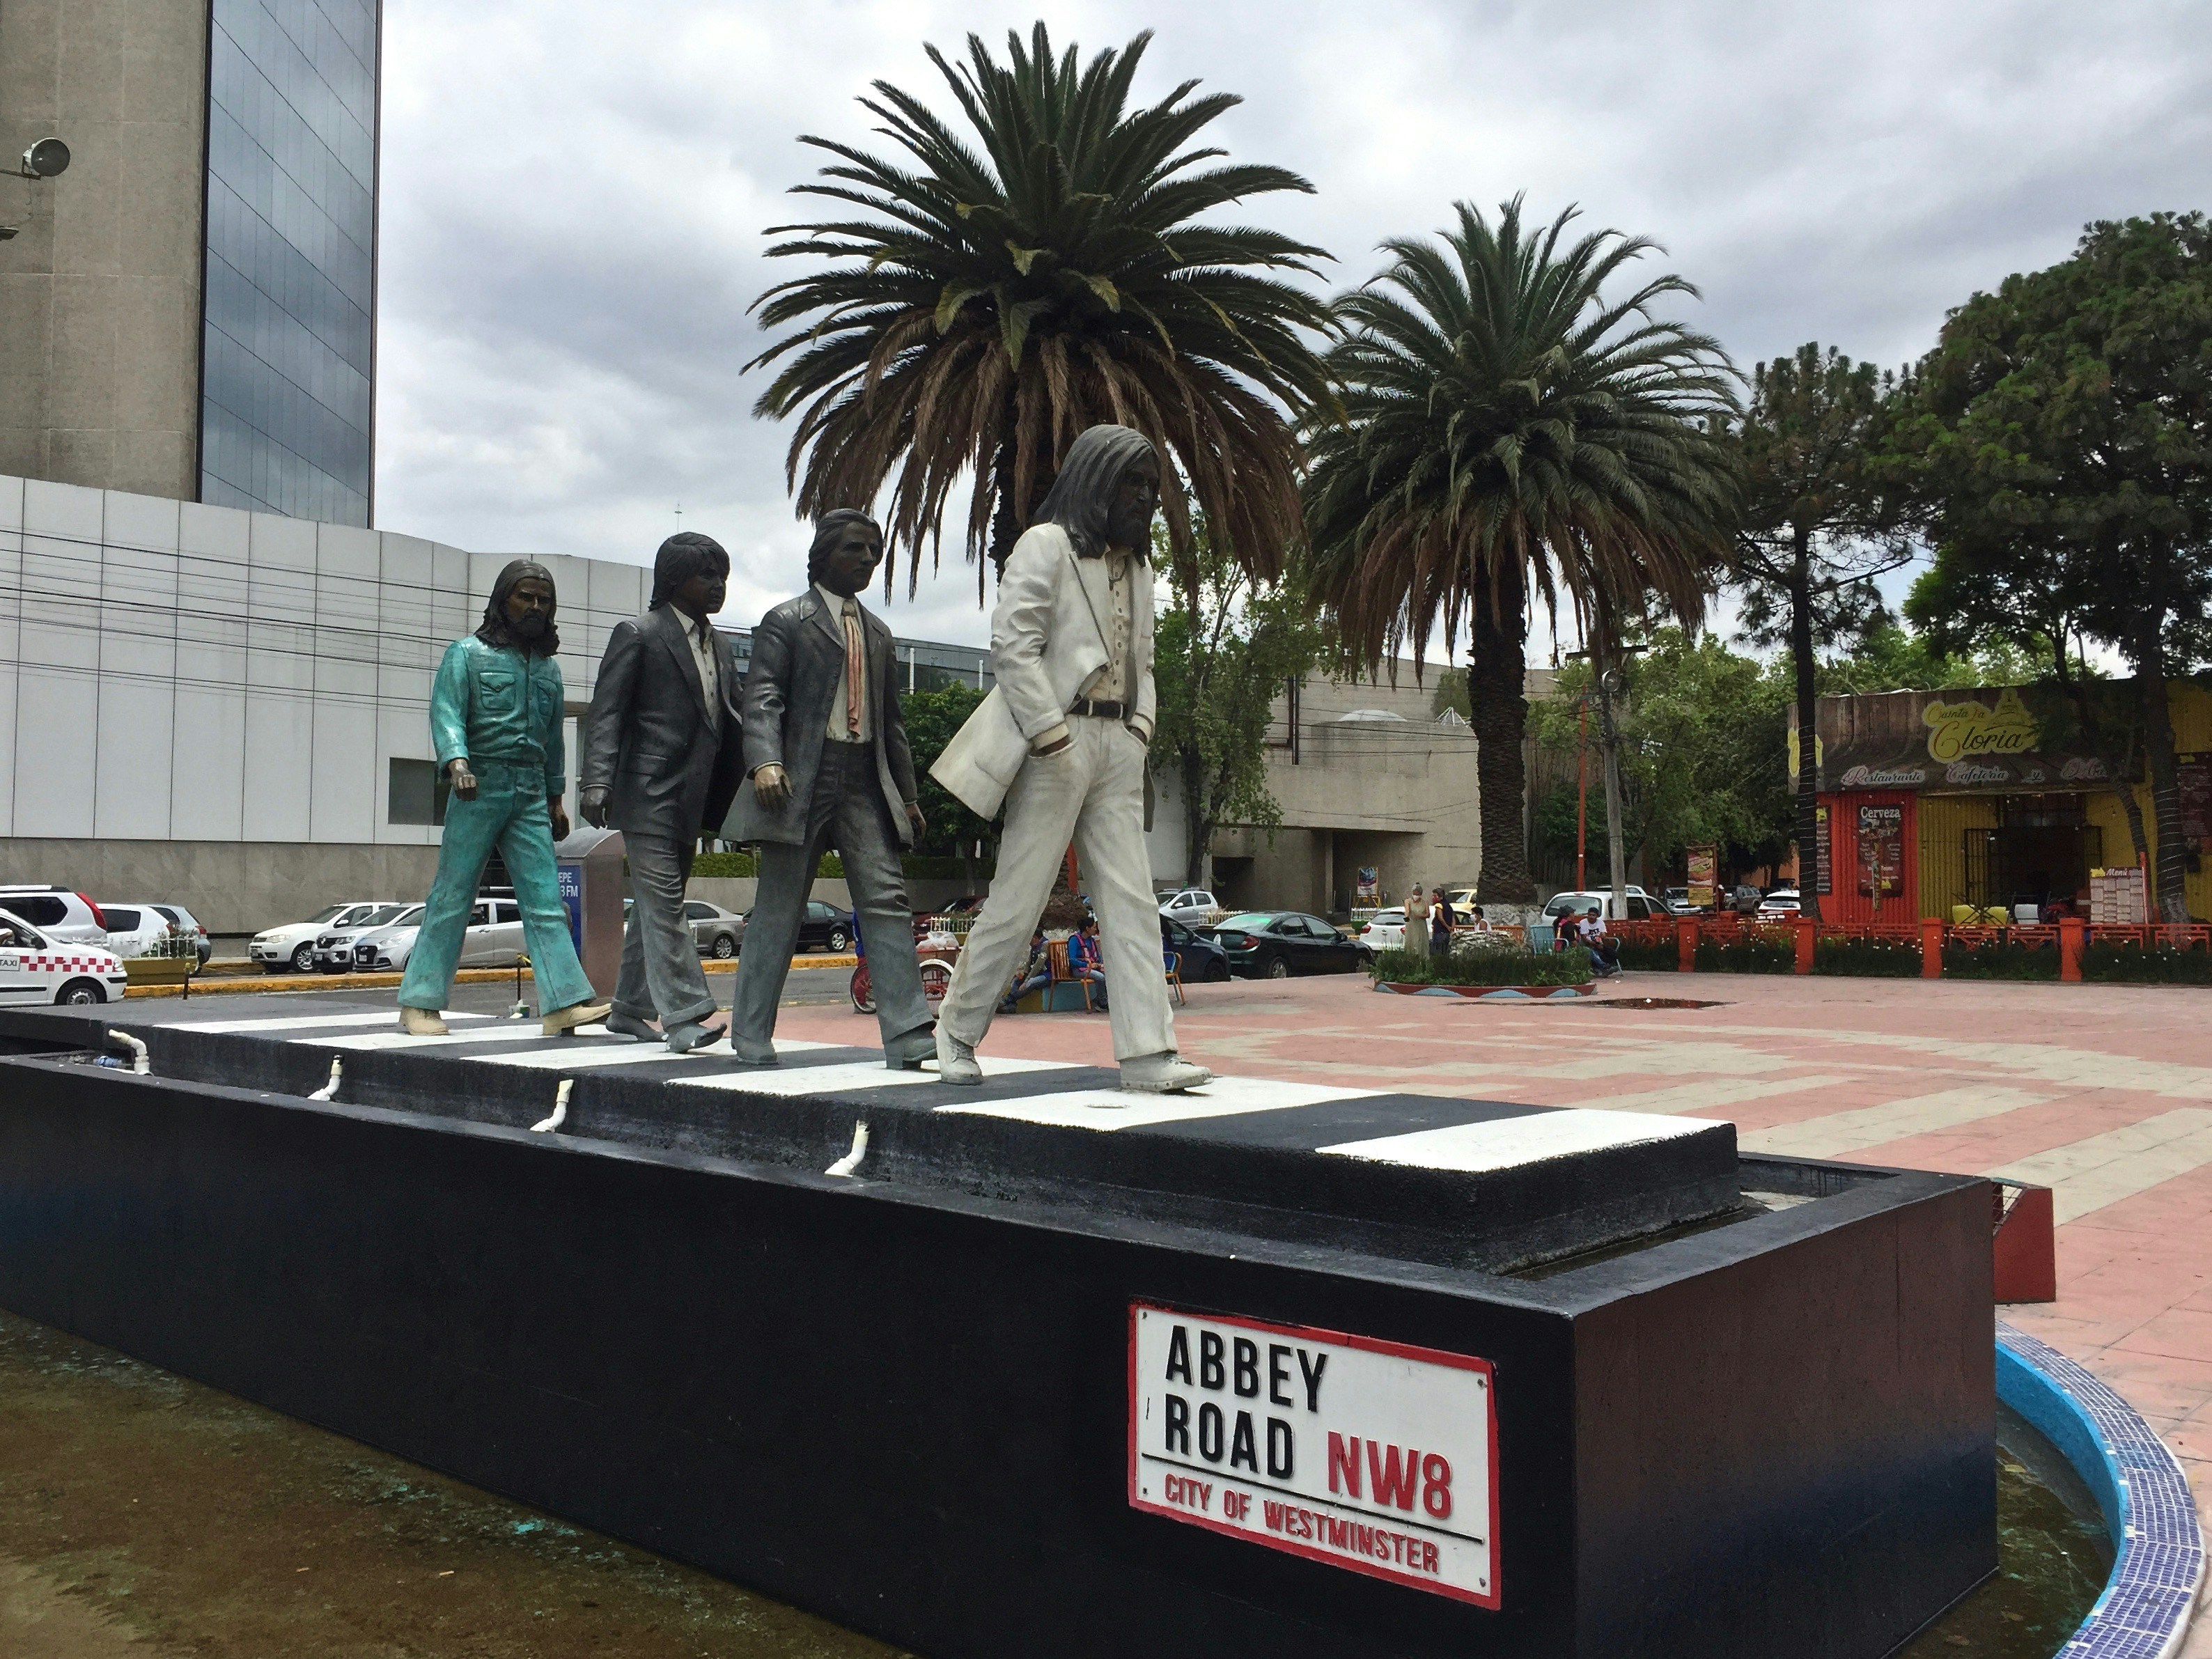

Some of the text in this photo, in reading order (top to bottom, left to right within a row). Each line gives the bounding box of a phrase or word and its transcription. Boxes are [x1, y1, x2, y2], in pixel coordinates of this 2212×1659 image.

[1933, 720, 2023, 758] Gloria
[1841, 767, 1922, 785] Restaurante
[1860, 806, 1901, 818] Cerveza
[558, 872, 573, 883] EPE
[566, 885, 579, 897] FM
[1165, 1325, 1329, 1412] ABBEY
[1165, 1393, 1295, 1480] ROAD
[1327, 1430, 1453, 1520] NW8
[1164, 1472, 1440, 1575] CITY OF WESTMINSTER
